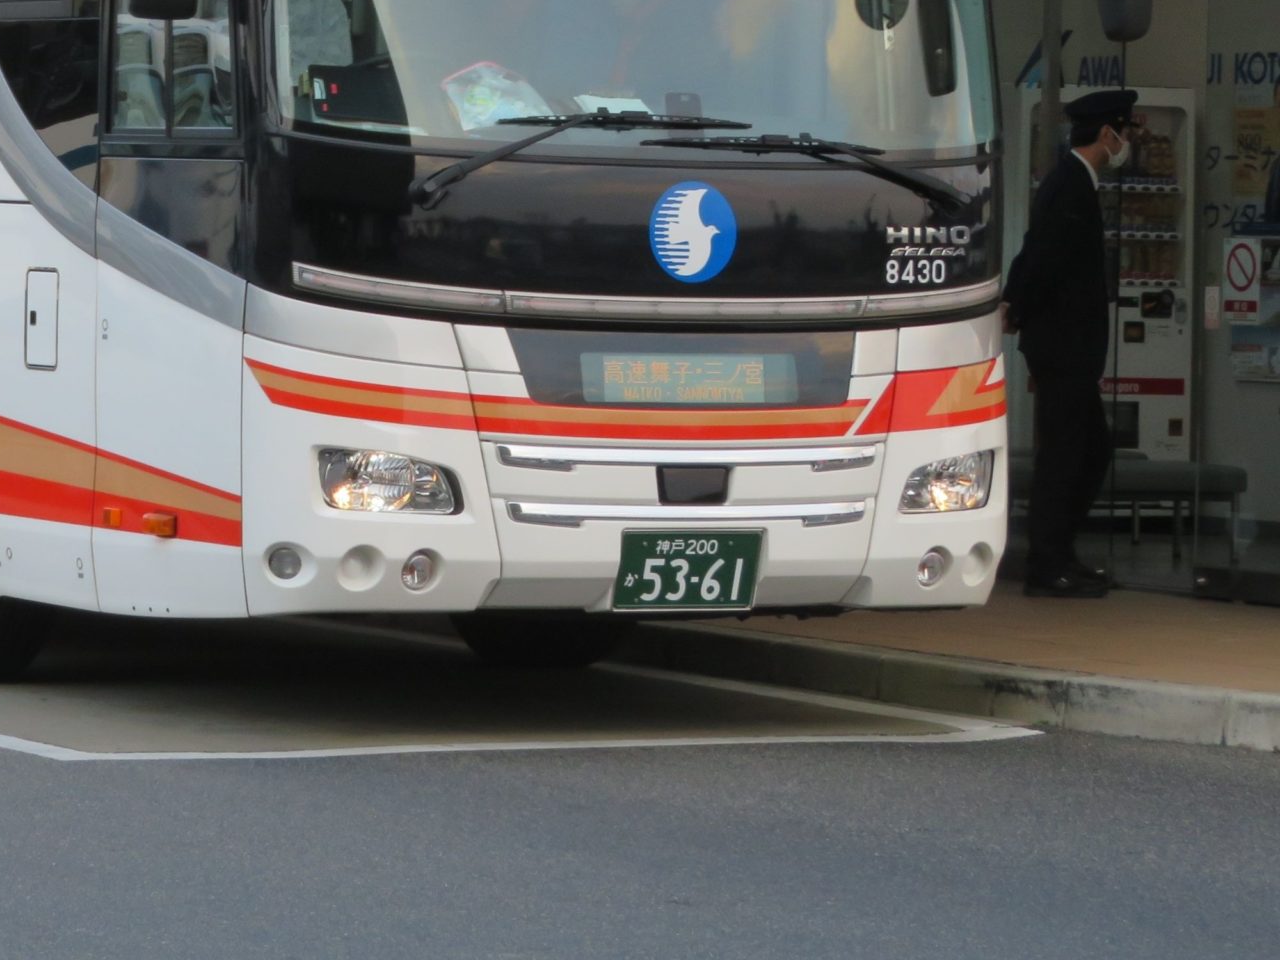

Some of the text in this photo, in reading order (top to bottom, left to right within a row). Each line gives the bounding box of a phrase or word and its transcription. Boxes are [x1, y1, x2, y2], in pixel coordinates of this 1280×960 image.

[886, 225, 970, 245] HINO
[886, 259, 945, 284] 8430
[624, 386, 661, 401] MAIKO
[623, 558, 743, 602] か 53-61
